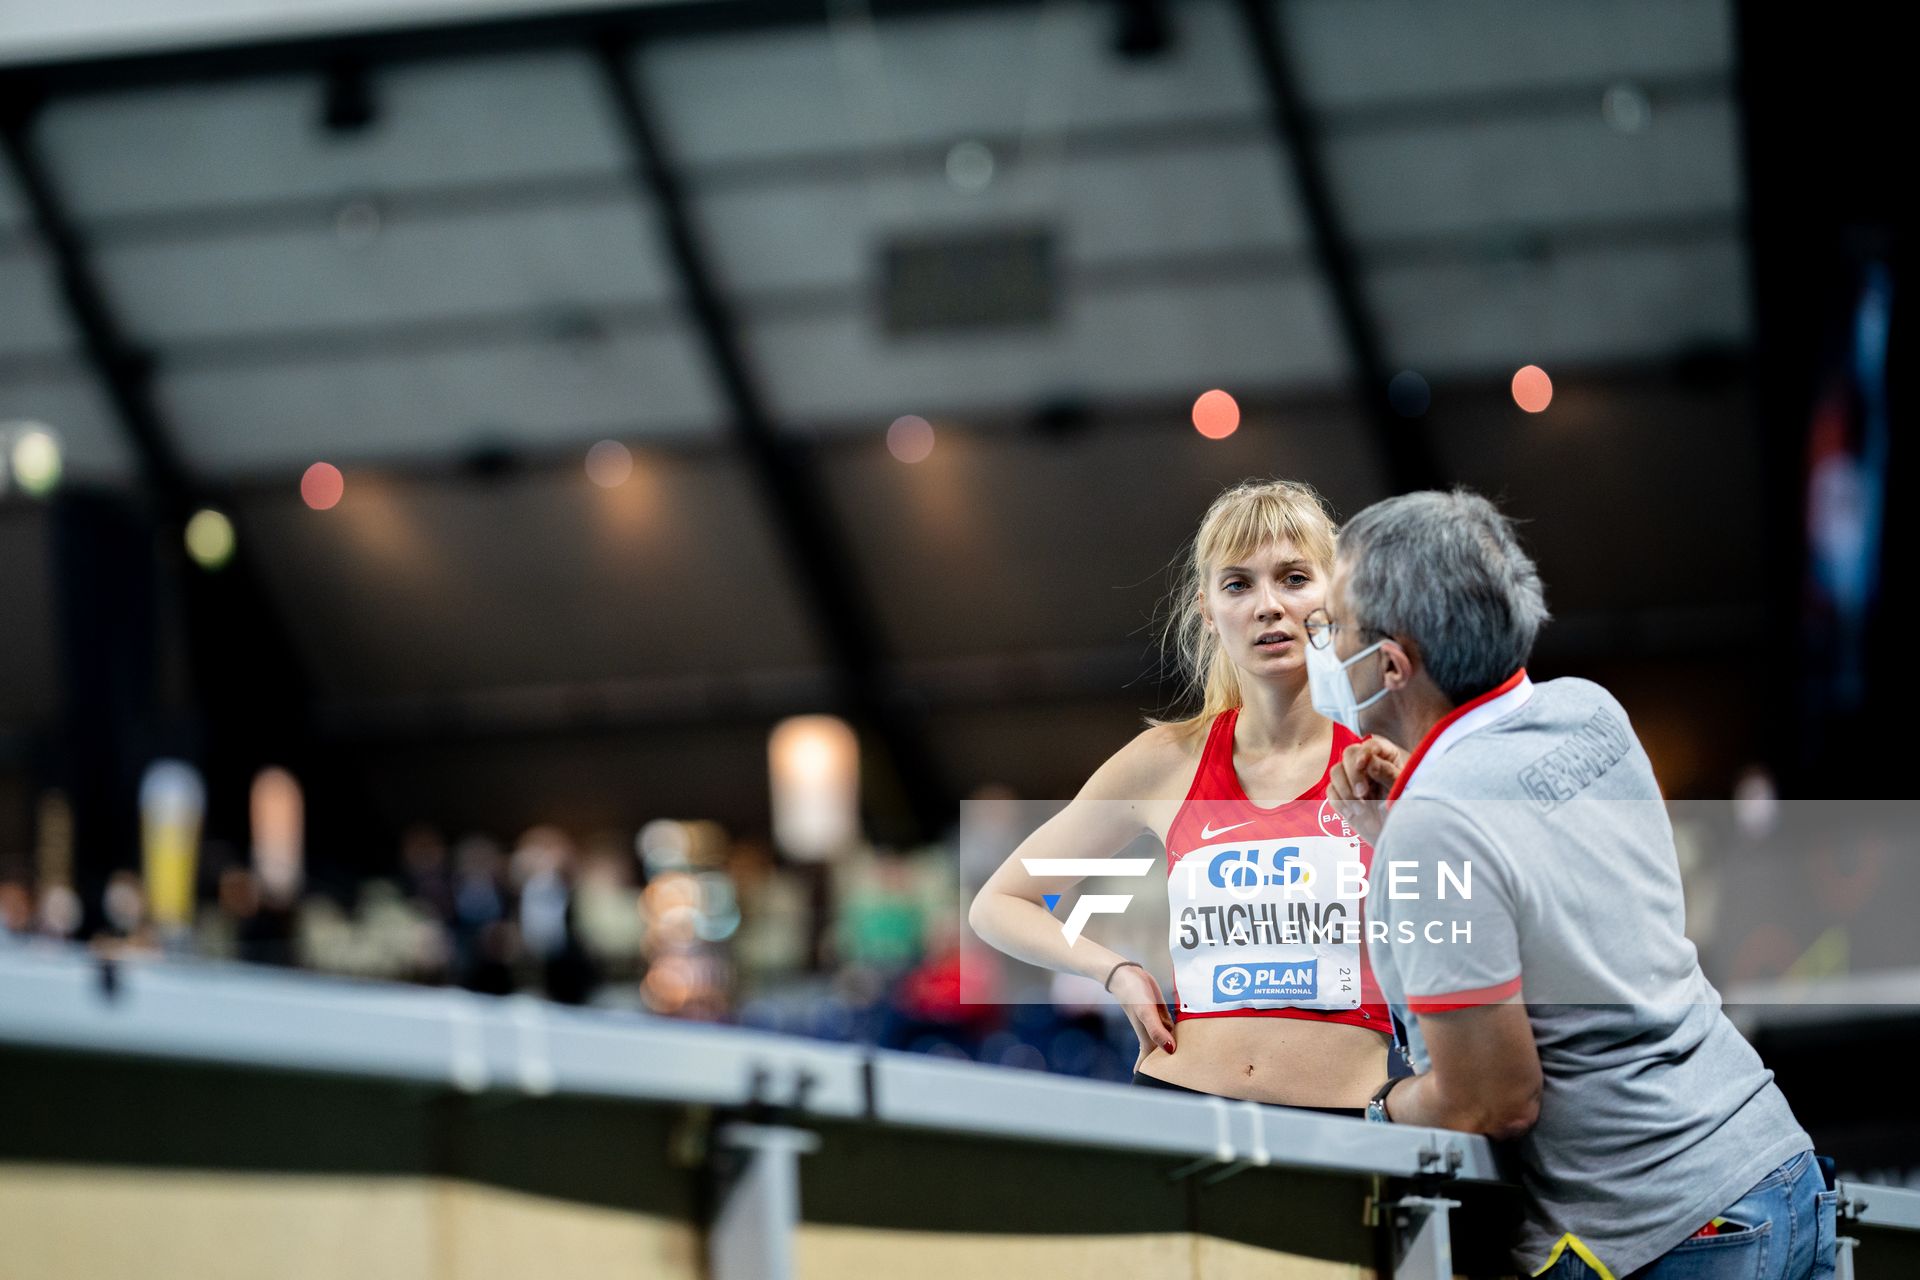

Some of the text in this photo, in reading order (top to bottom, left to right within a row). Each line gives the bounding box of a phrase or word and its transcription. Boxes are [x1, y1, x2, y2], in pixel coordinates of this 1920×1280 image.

[1518, 706, 1631, 814] GERMANY
[1180, 902, 1347, 950] STICHLING
[1255, 968, 1312, 985] PLAN
[1339, 967, 1351, 992] 214
[1254, 987, 1312, 995] INTERNATIONAL
